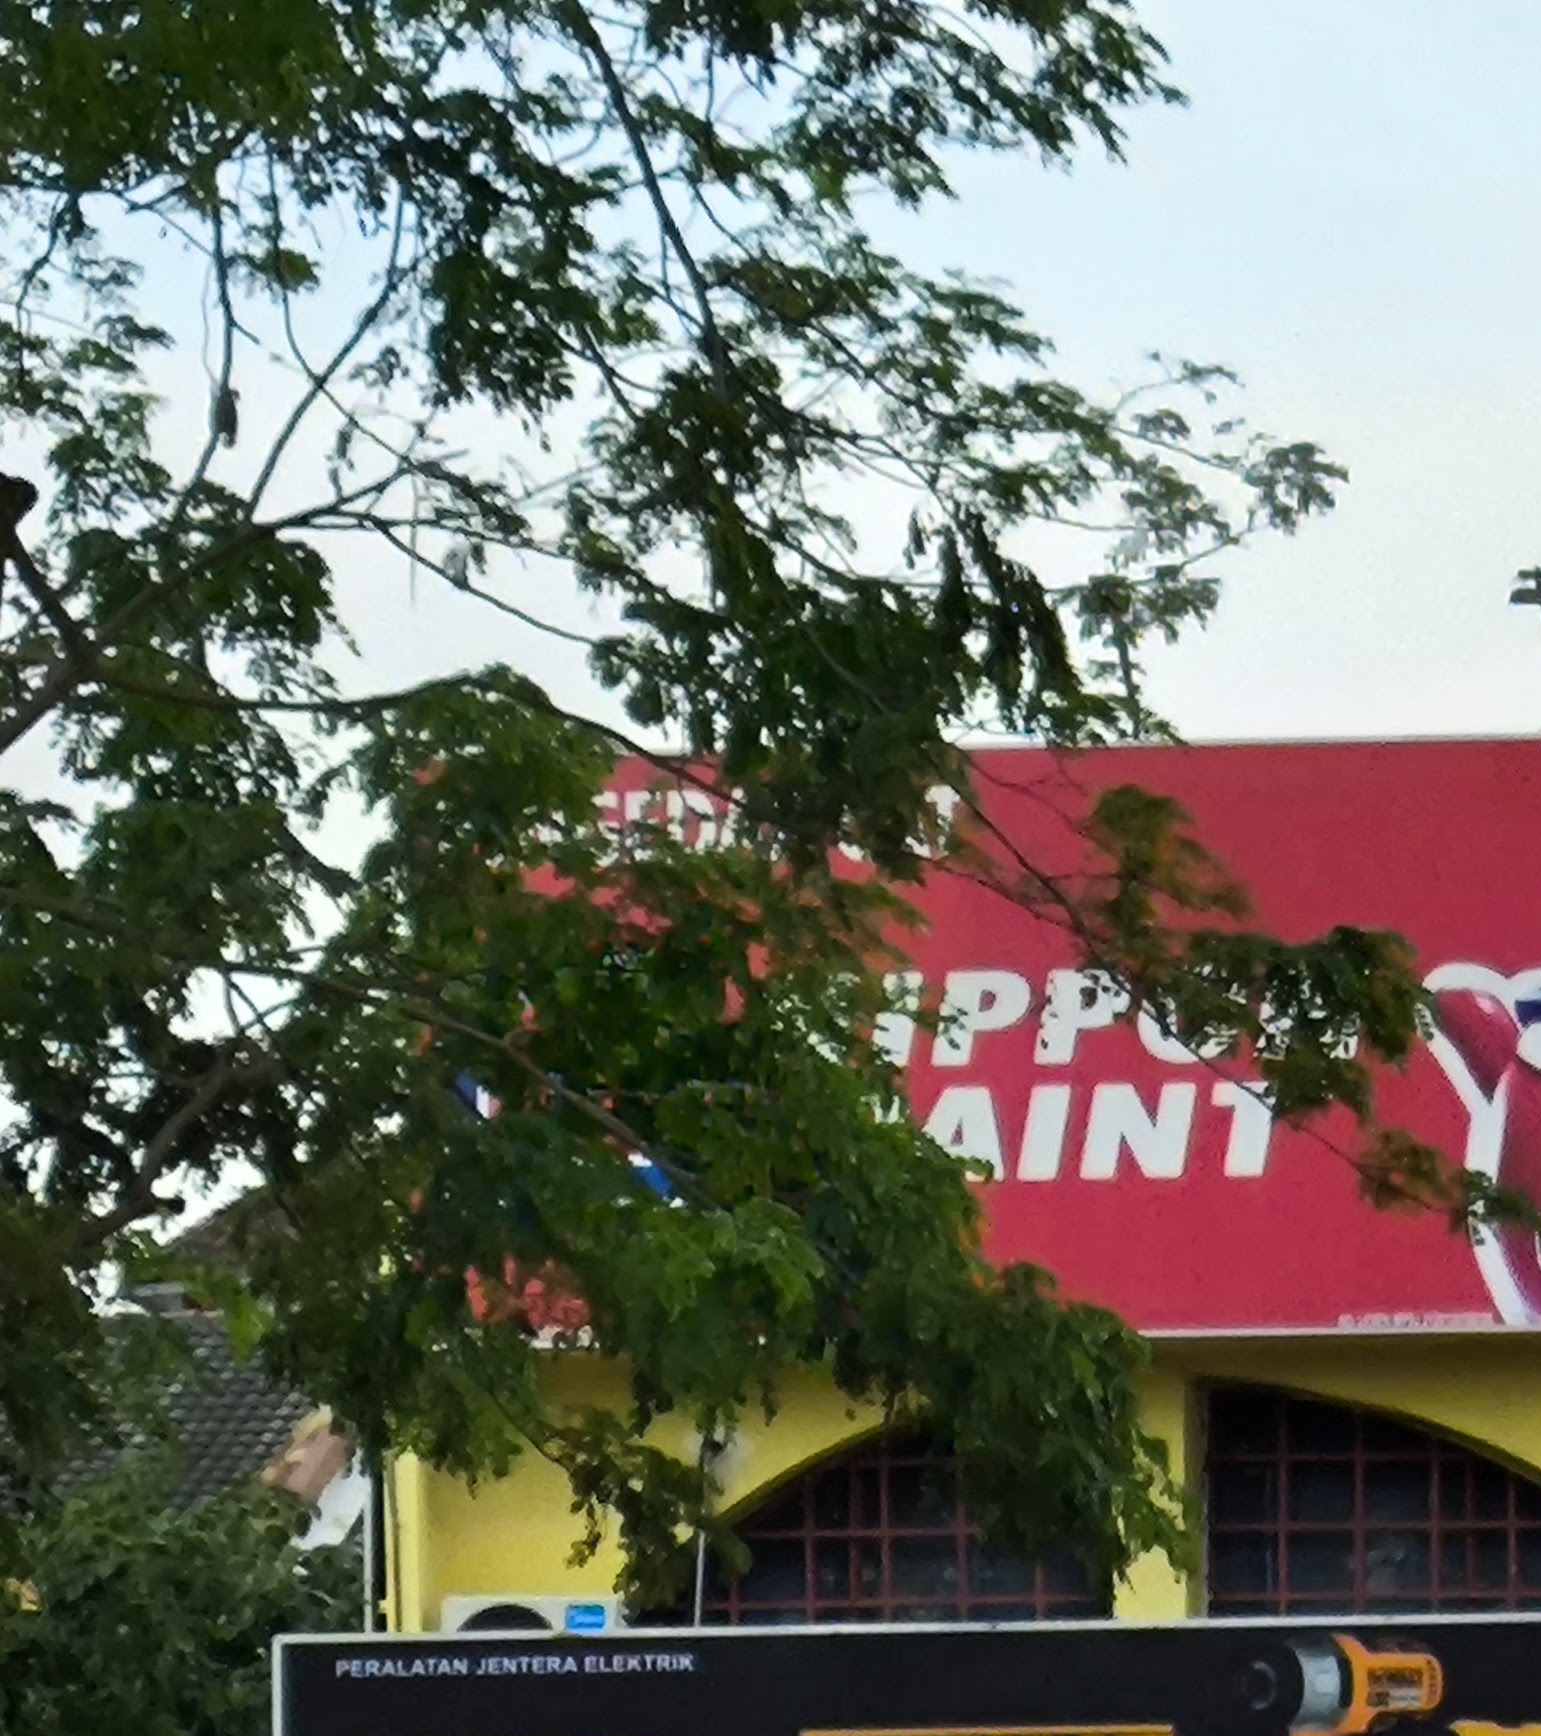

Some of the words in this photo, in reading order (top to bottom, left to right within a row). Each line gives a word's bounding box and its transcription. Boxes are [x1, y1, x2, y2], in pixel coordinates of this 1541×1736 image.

[866, 1082, 1278, 1182] AINT
[336, 1658, 468, 1678] PERALATAN
[476, 1656, 578, 1676] JENTERA
[584, 1653, 694, 1673] ELEKTRIK
